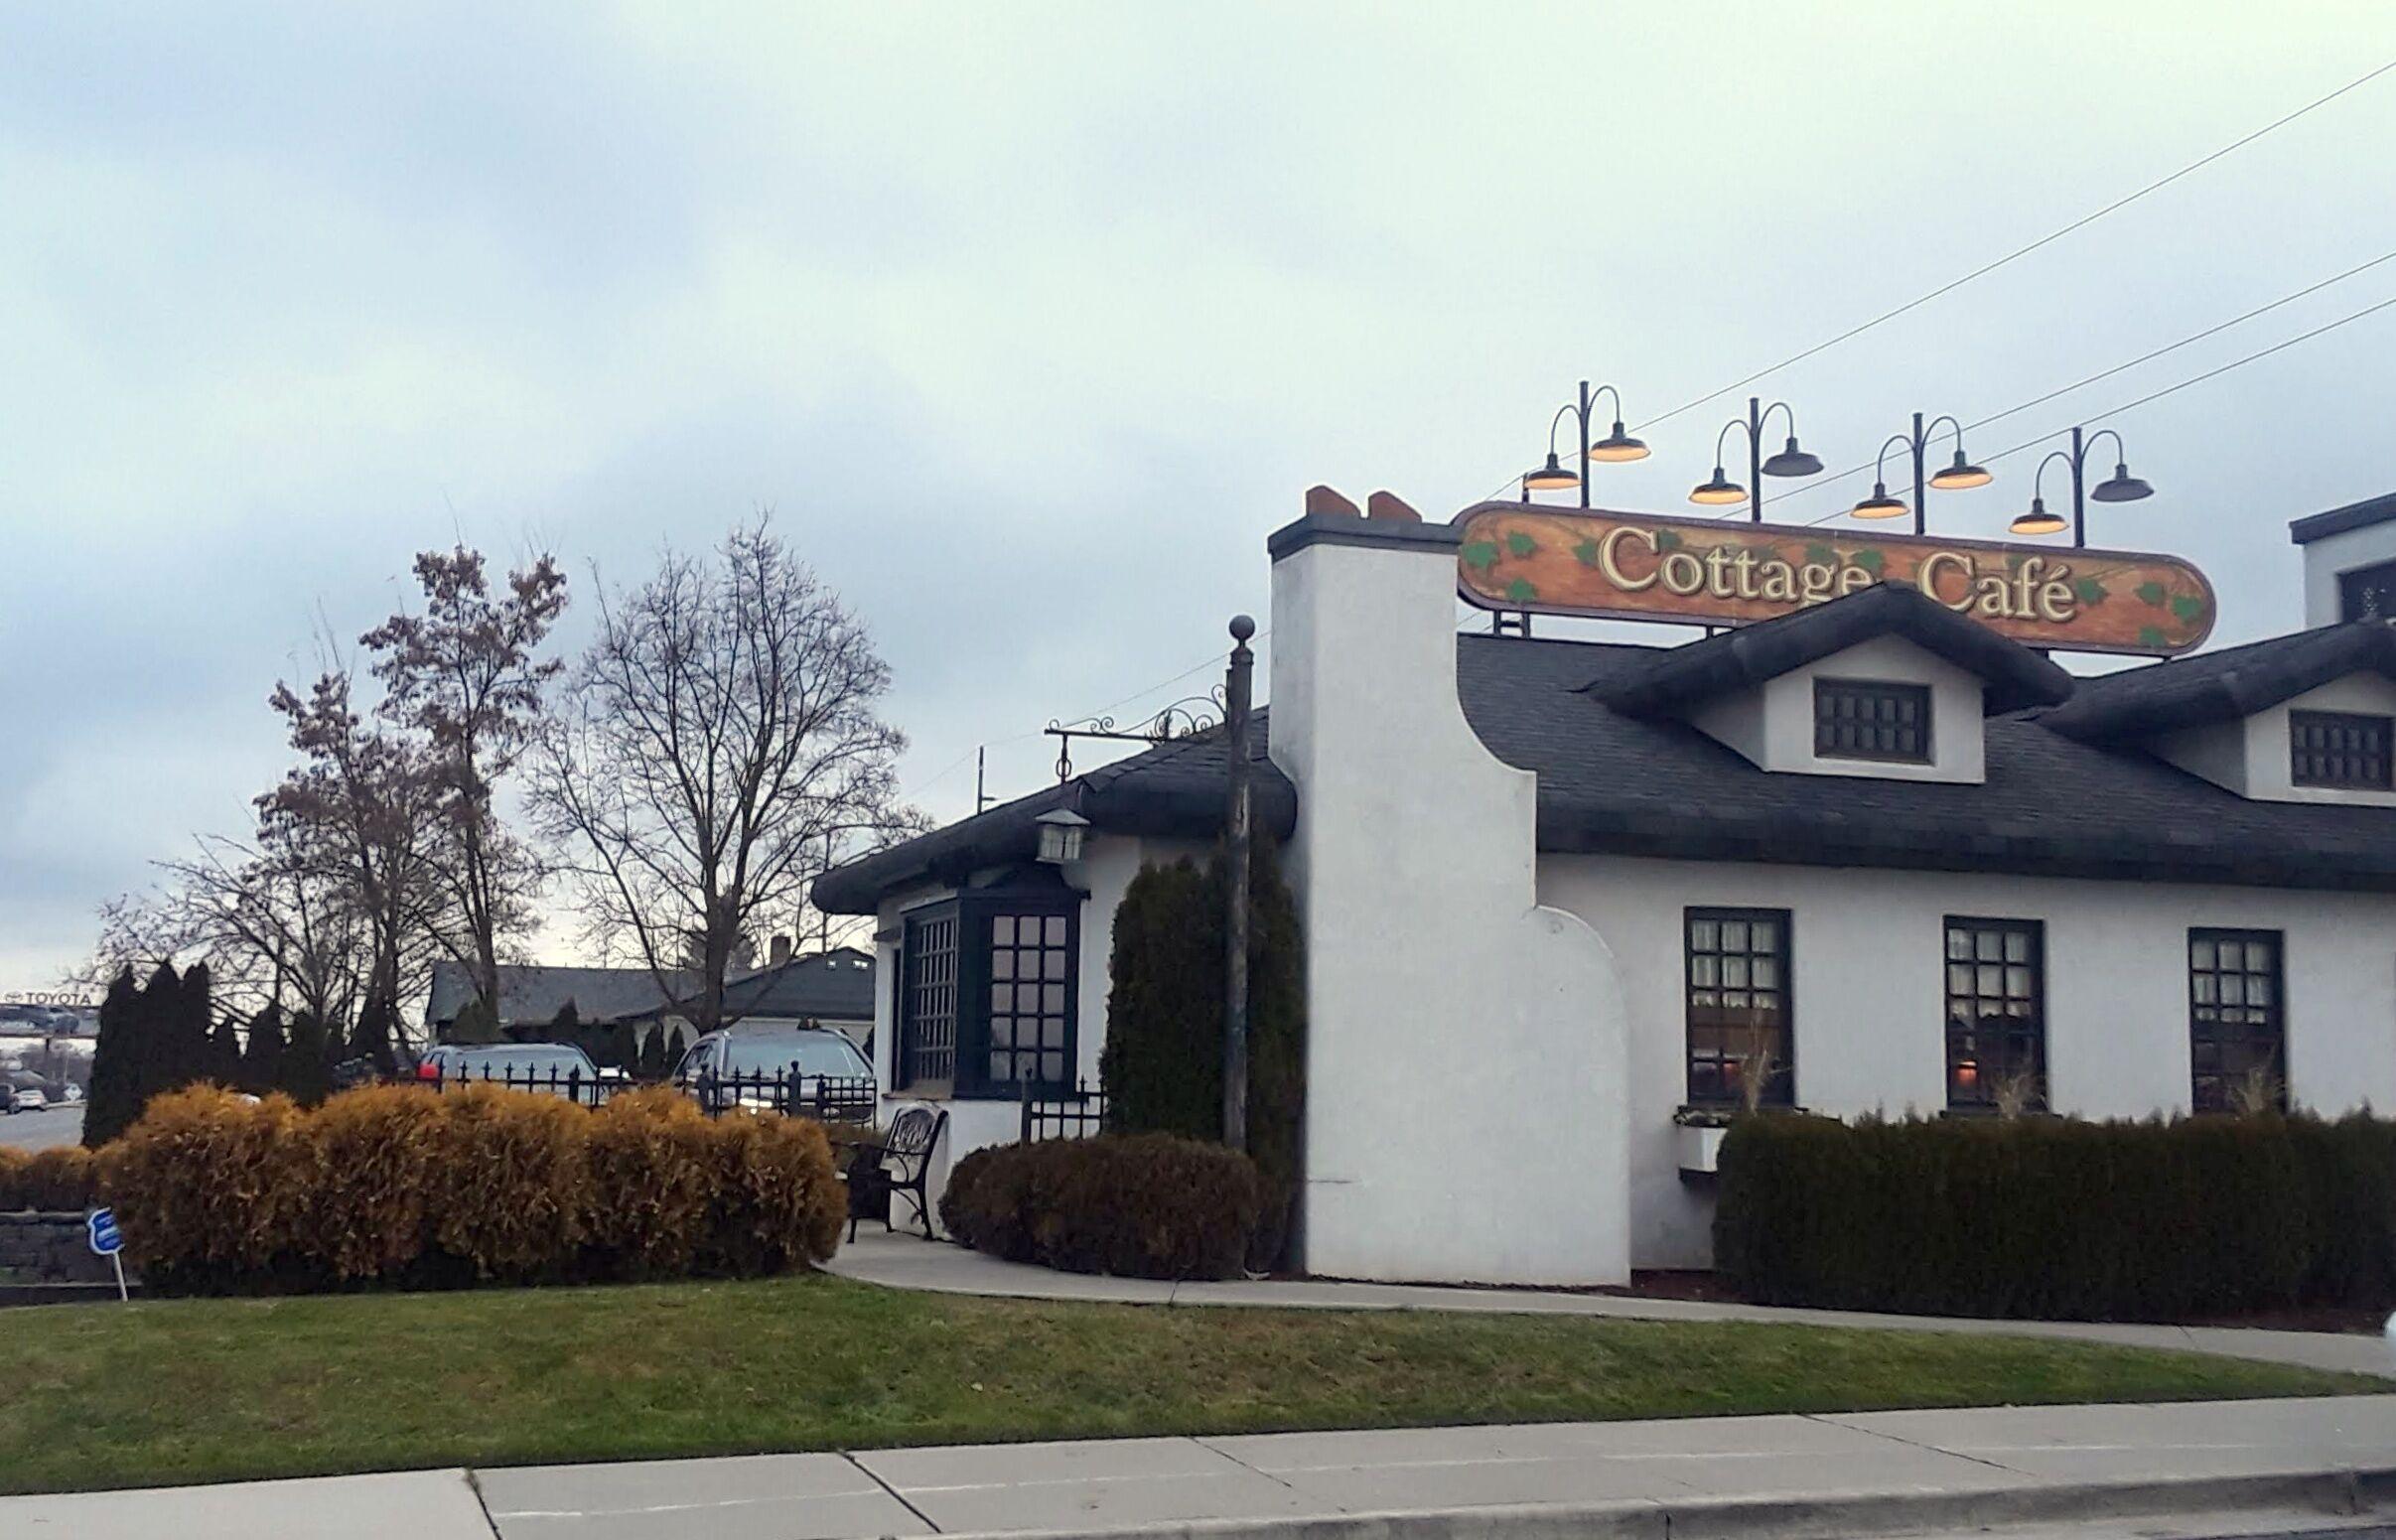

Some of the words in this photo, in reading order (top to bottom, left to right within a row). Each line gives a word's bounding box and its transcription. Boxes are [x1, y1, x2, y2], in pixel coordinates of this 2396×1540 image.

[1598, 526, 1878, 611] Cottage
[1917, 551, 2077, 623] Café
[26, 993, 91, 1005] TOYOTA
